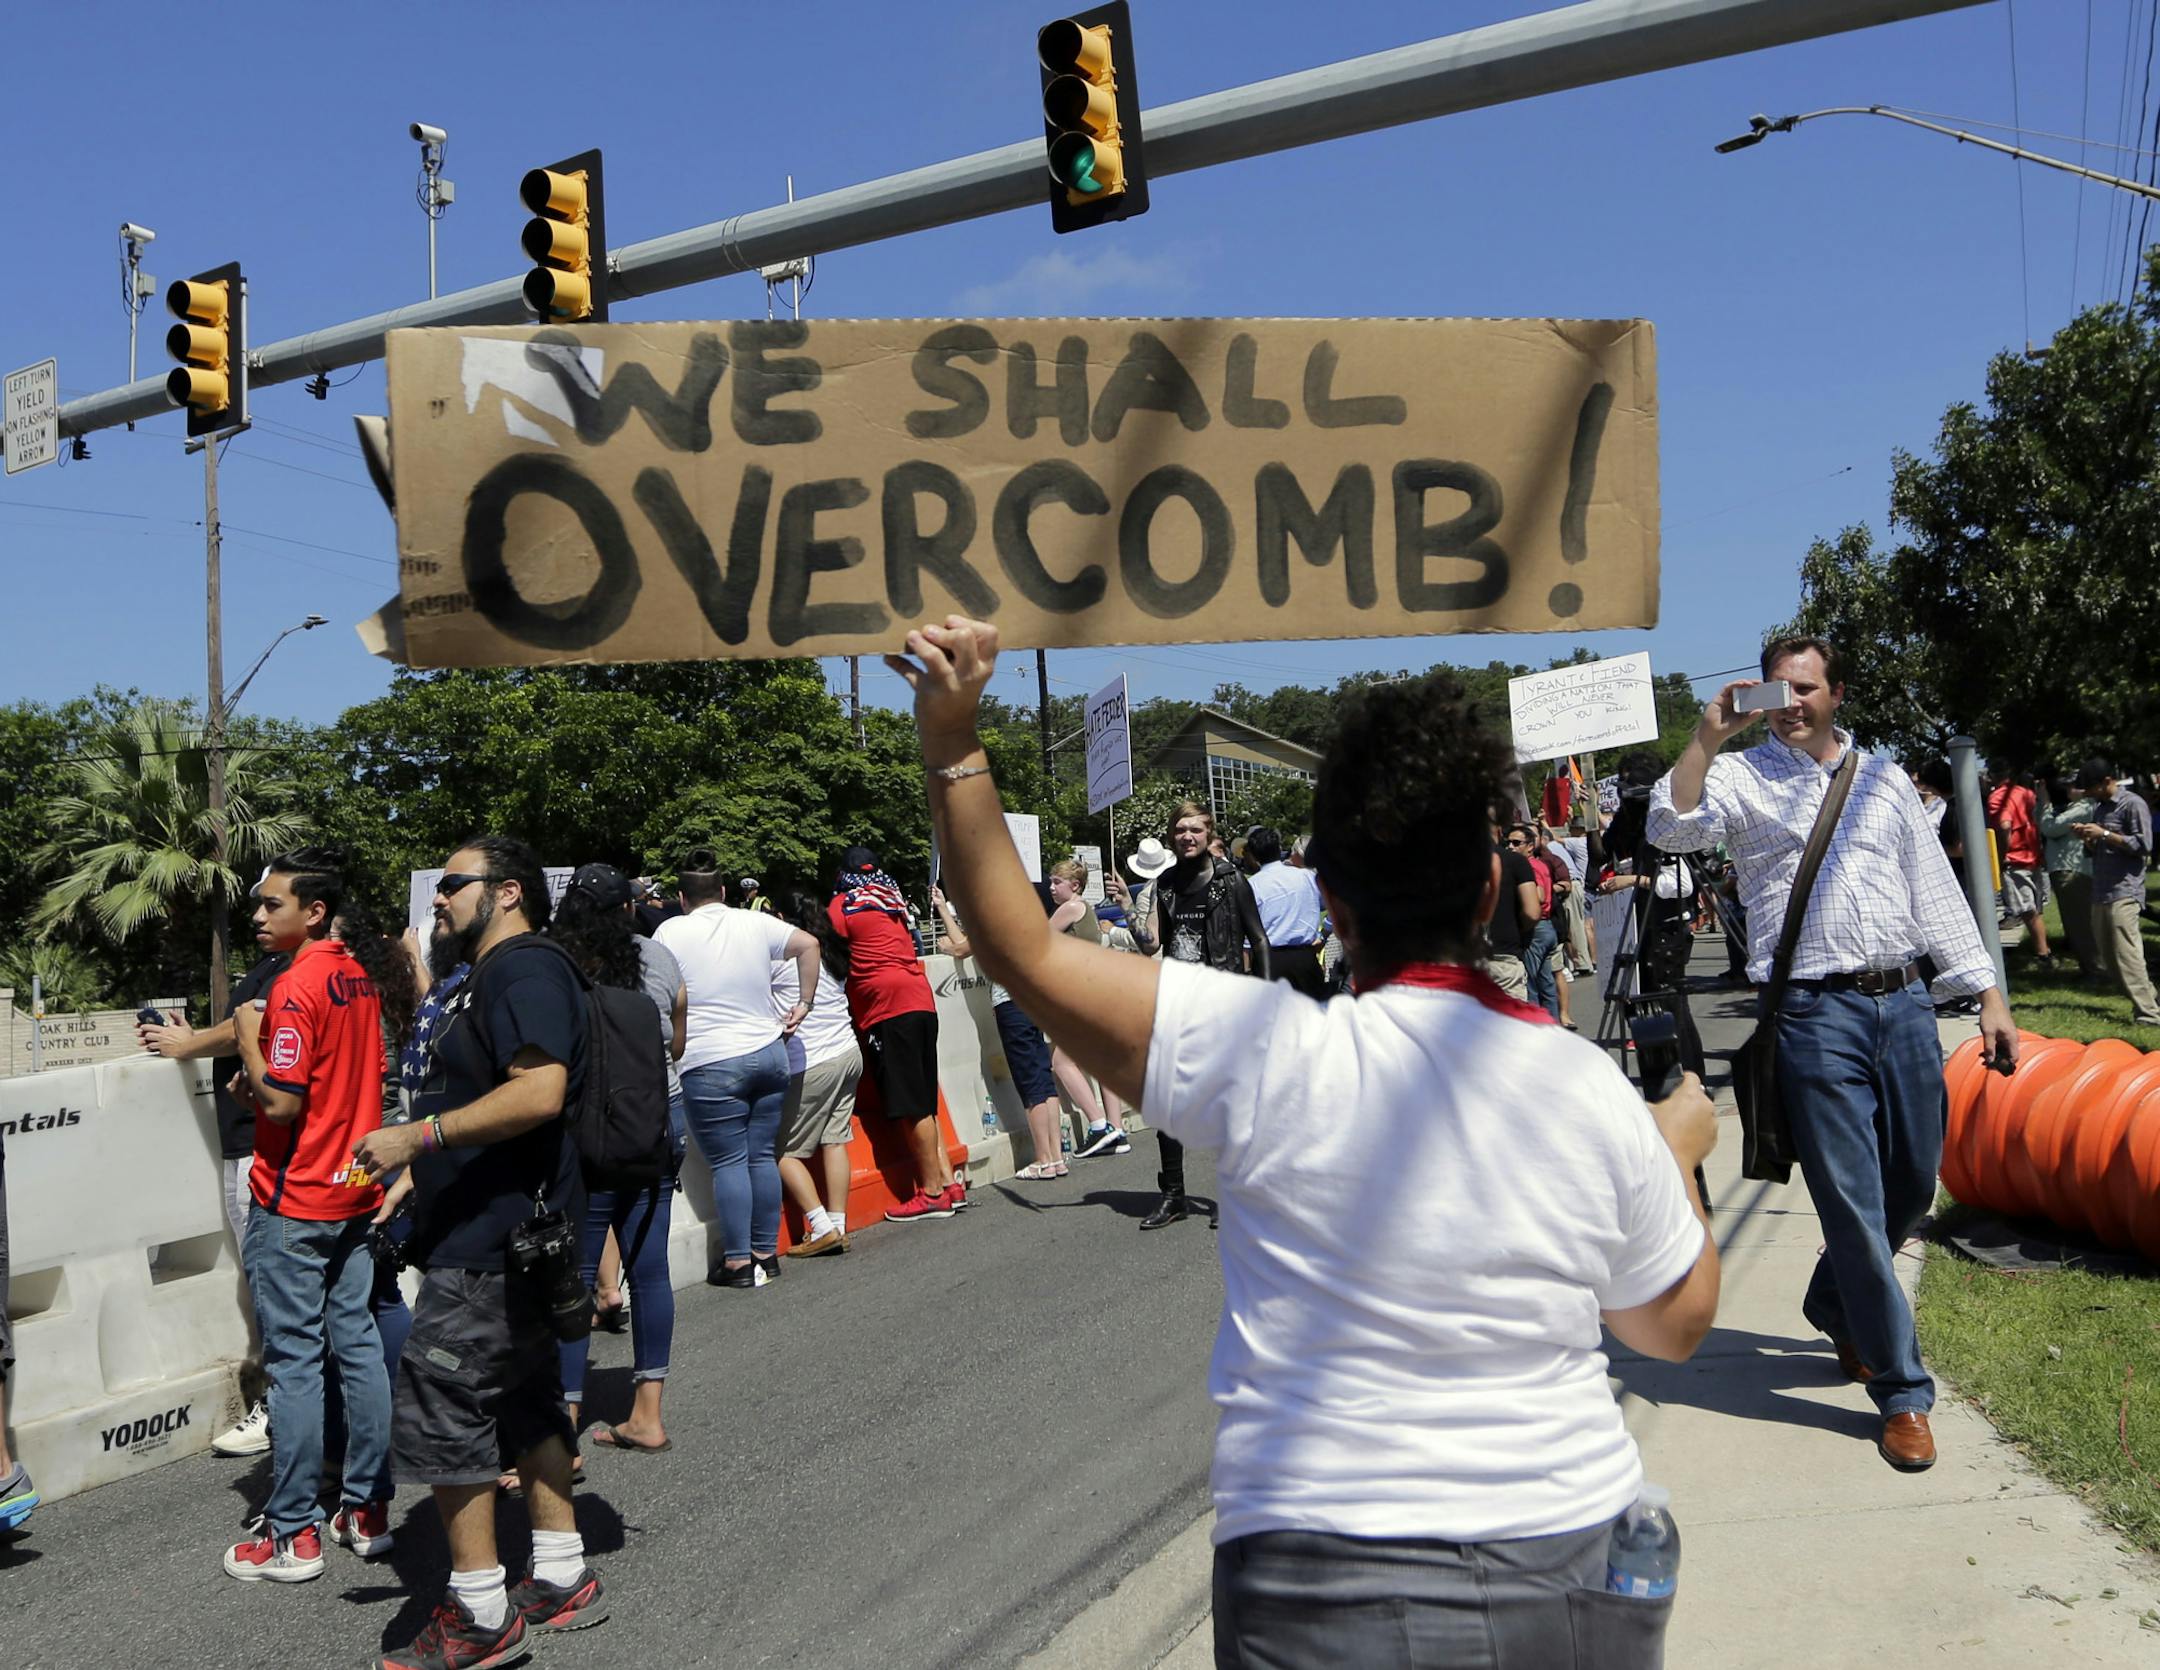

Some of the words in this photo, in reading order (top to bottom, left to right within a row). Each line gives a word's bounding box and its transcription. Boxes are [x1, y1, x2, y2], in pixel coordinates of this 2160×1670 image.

[9, 376, 27, 393] LEFT
[30, 366, 51, 384] TURN
[525, 321, 823, 453] WE
[904, 324, 1408, 447] SHALL
[17, 389, 44, 411] YIELD
[8, 421, 18, 434] ON
[20, 407, 54, 428] FLASHING
[16, 428, 46, 448] YELLOW
[19, 445, 45, 464] ARROW
[1511, 674, 1578, 701] TYRANT
[1587, 662, 1637, 682] FIEND
[1515, 693, 1559, 720] DIVIDING
[1570, 683, 1612, 696] NATION
[1546, 700, 1574, 715] WILL
[1582, 692, 1615, 704] NEVER
[1518, 719, 1556, 736] CROWN
[1575, 709, 1592, 720] YOU
[40, 1024, 61, 1034] OAK
[67, 1021, 96, 1033] HILLS
[26, 1037, 76, 1051] CUNTRY
[84, 1036, 109, 1047] CLUB
[101, 1404, 191, 1452] YODOCK
